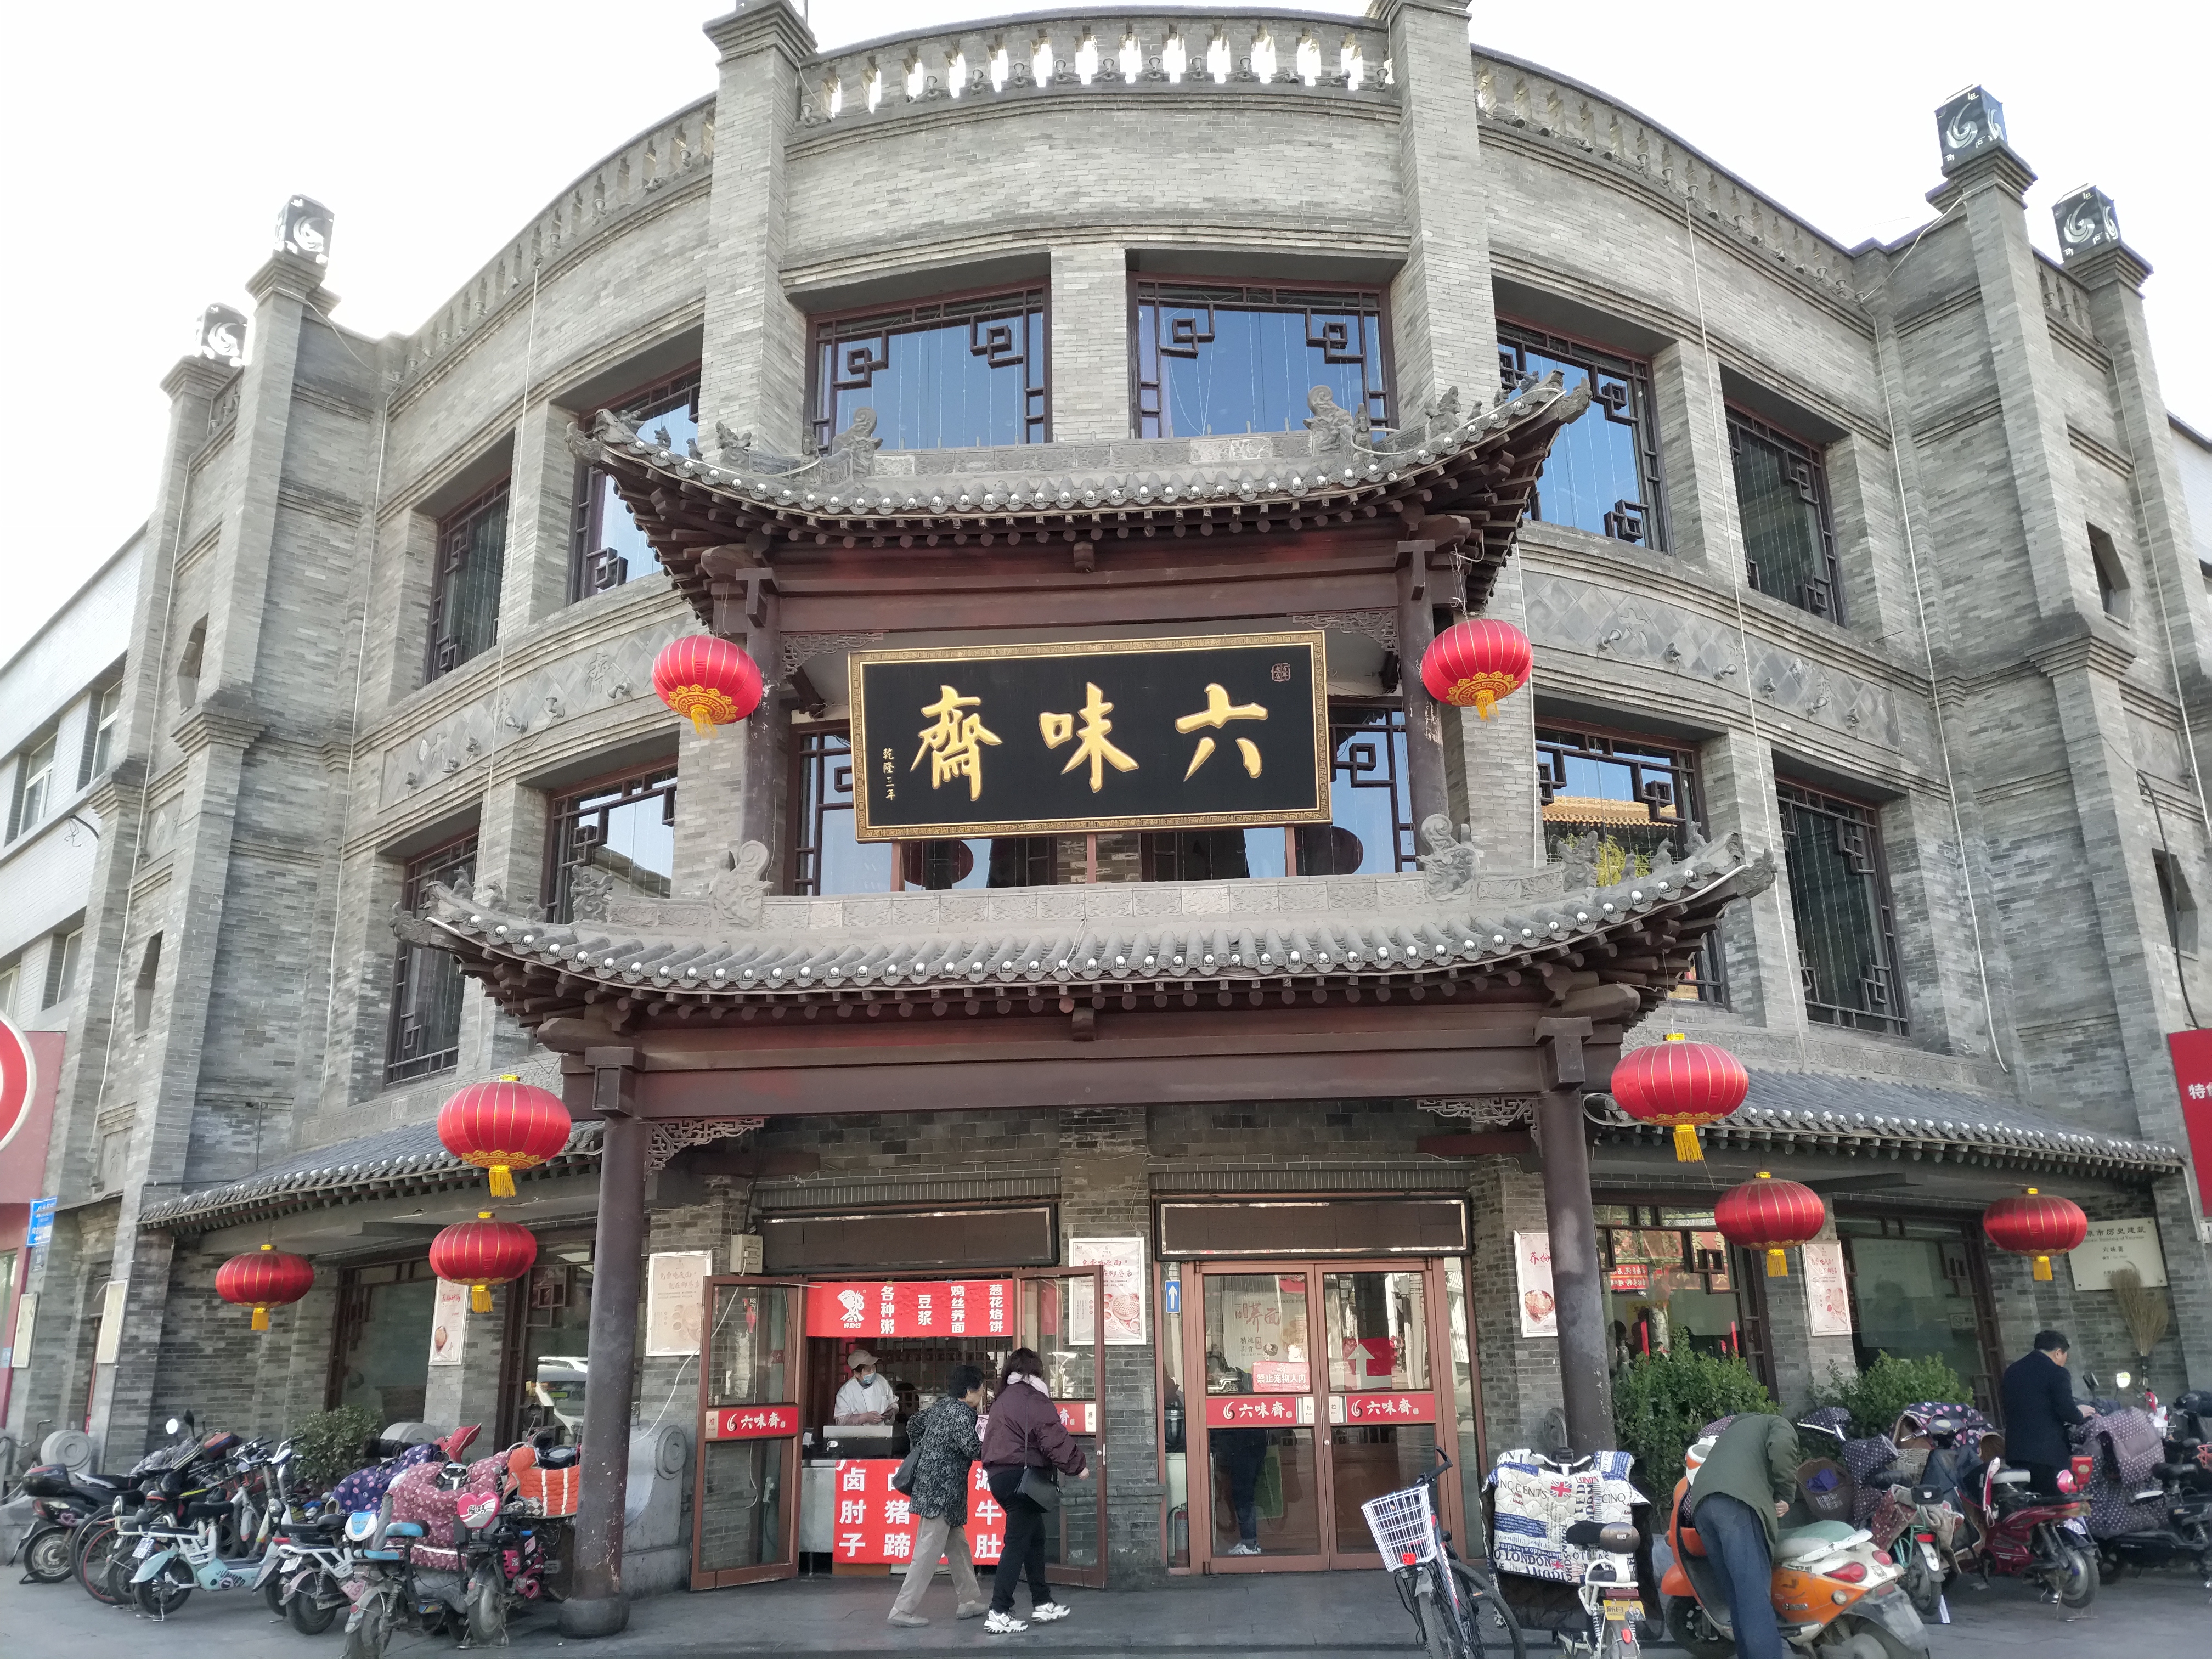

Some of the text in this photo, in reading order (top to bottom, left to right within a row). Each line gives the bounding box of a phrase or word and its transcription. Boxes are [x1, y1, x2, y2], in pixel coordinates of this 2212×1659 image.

[2188, 1083, 2206, 1100] 特
[2086, 1226, 2146, 1237] 原市历史建筑
[880, 1286, 895, 1334] 各种粥
[918, 1294, 932, 1325] 豆浆
[951, 1285, 965, 1333] 鸡丝荞面
[989, 1284, 1003, 1333] 葱花烙饼
[1515, 1483, 1548, 1499] CENTS
[1601, 1493, 1626, 1505] CINQ
[468, 1505, 486, 1514] 爱玛
[839, 1468, 867, 1558] 卤肘子
[1505, 1551, 1552, 1567] LONDON
